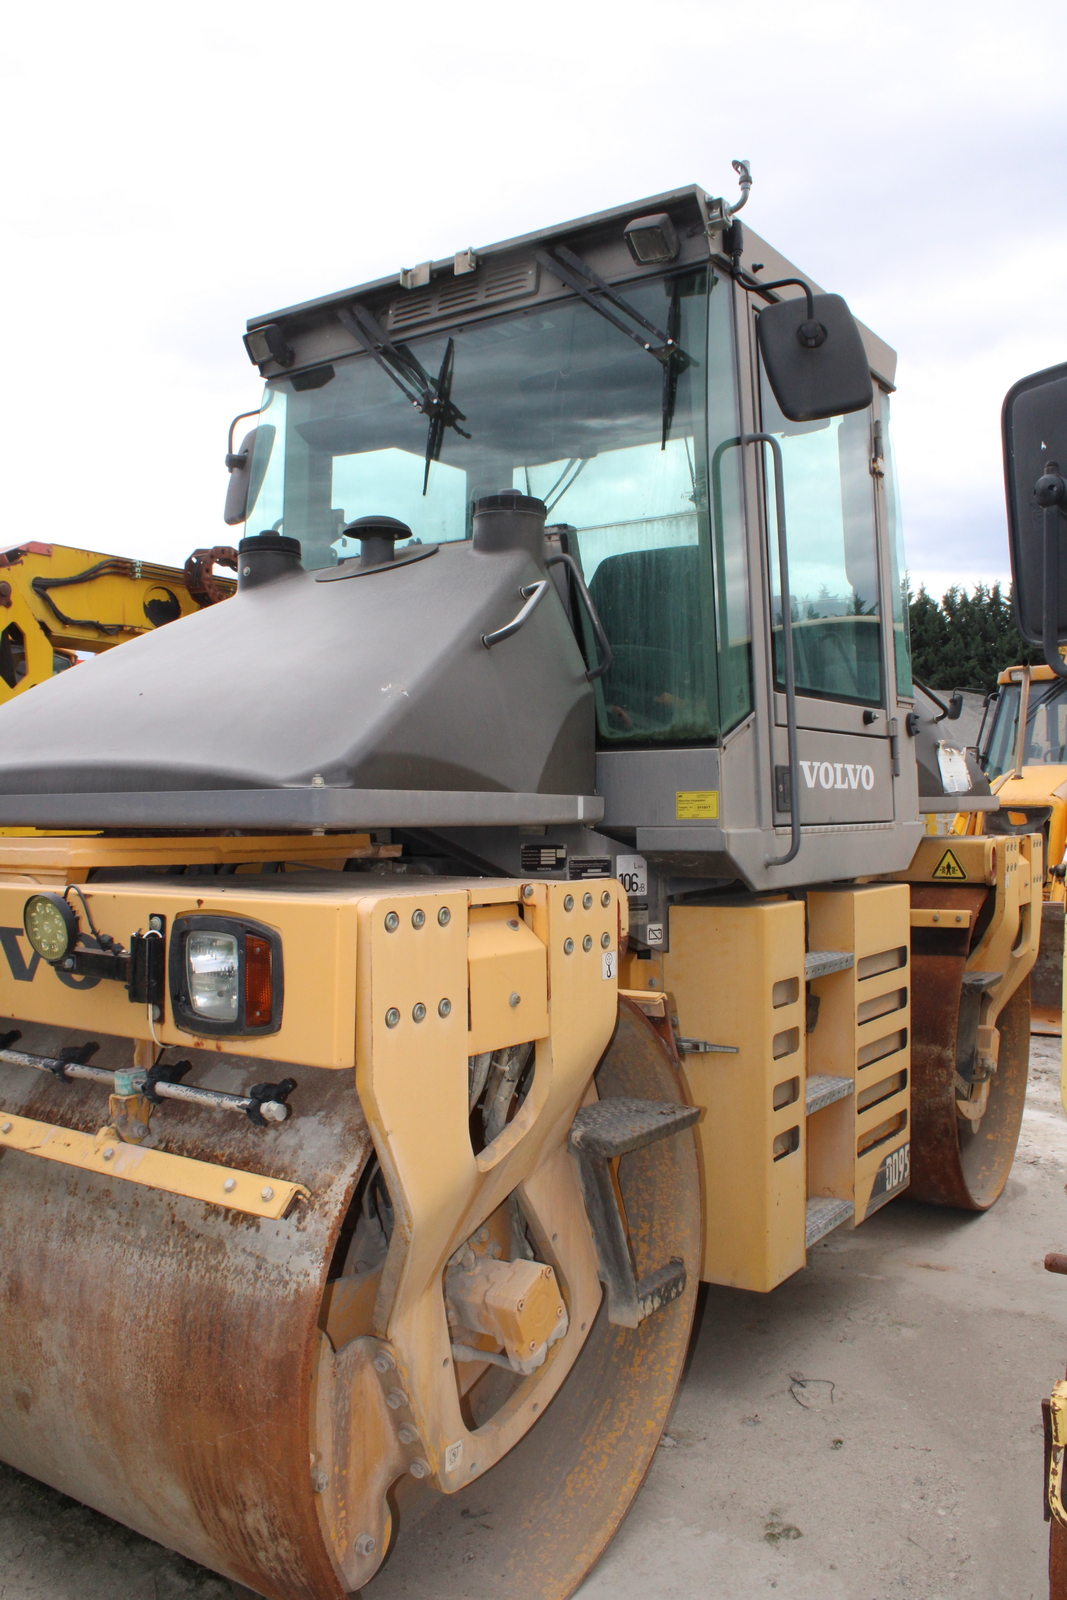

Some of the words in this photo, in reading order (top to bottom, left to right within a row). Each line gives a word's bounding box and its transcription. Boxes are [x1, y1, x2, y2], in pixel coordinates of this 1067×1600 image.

[799, 761, 875, 790] VOLVO
[618, 872, 639, 893] 106
[885, 1143, 910, 1191] DD95
